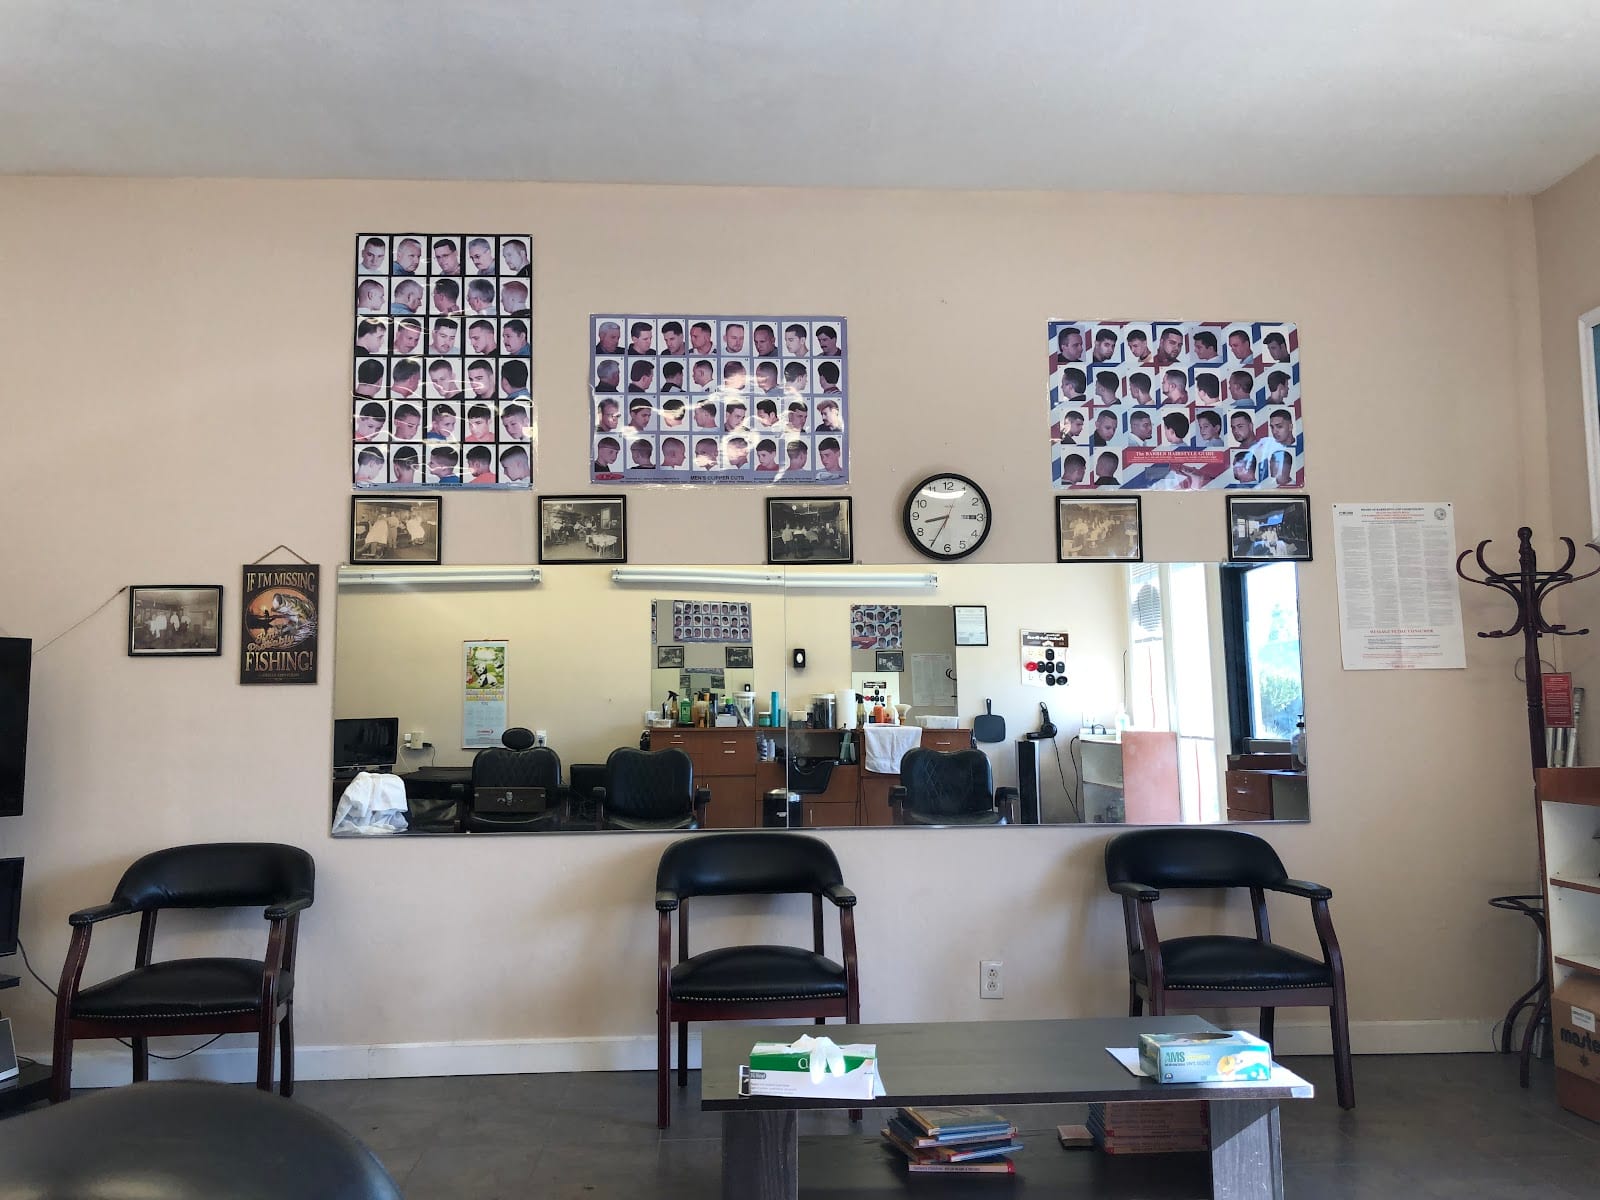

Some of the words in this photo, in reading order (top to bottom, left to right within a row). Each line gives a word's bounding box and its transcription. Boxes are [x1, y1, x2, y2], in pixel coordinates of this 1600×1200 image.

[942, 481, 954, 491] 12
[916, 499, 927, 509] 10
[971, 497, 979, 506] 2
[912, 511, 920, 521] 9
[976, 513, 984, 522] 3
[916, 527, 924, 537] 8
[970, 529, 978, 538] 4
[943, 543, 952, 553] 6
[959, 540, 966, 549] 5
[246, 572, 257, 593] IF
[258, 572, 272, 589] I'M
[274, 572, 315, 593] MISSING
[245, 650, 313, 672] FISHING!
